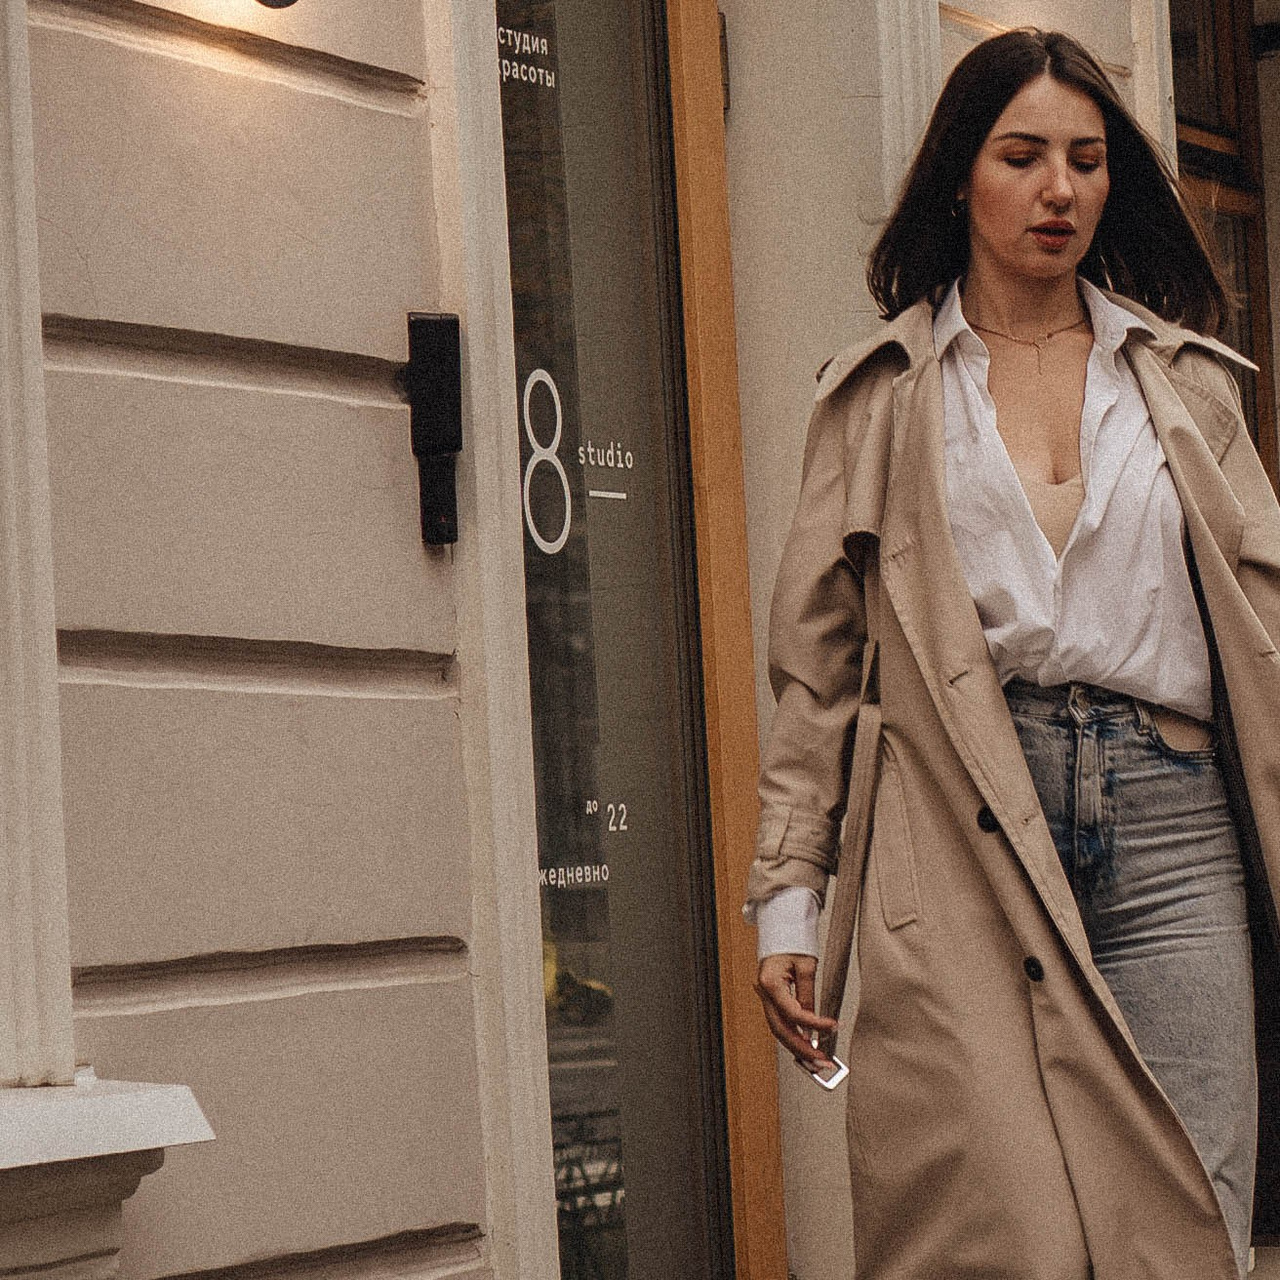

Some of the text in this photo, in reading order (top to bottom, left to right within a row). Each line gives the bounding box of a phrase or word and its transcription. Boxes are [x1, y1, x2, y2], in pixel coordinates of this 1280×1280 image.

[498, 26, 549, 56] студия
[523, 368, 634, 555] 8 studio
[586, 799, 628, 832] до 22
[538, 863, 610, 889] жедневно
